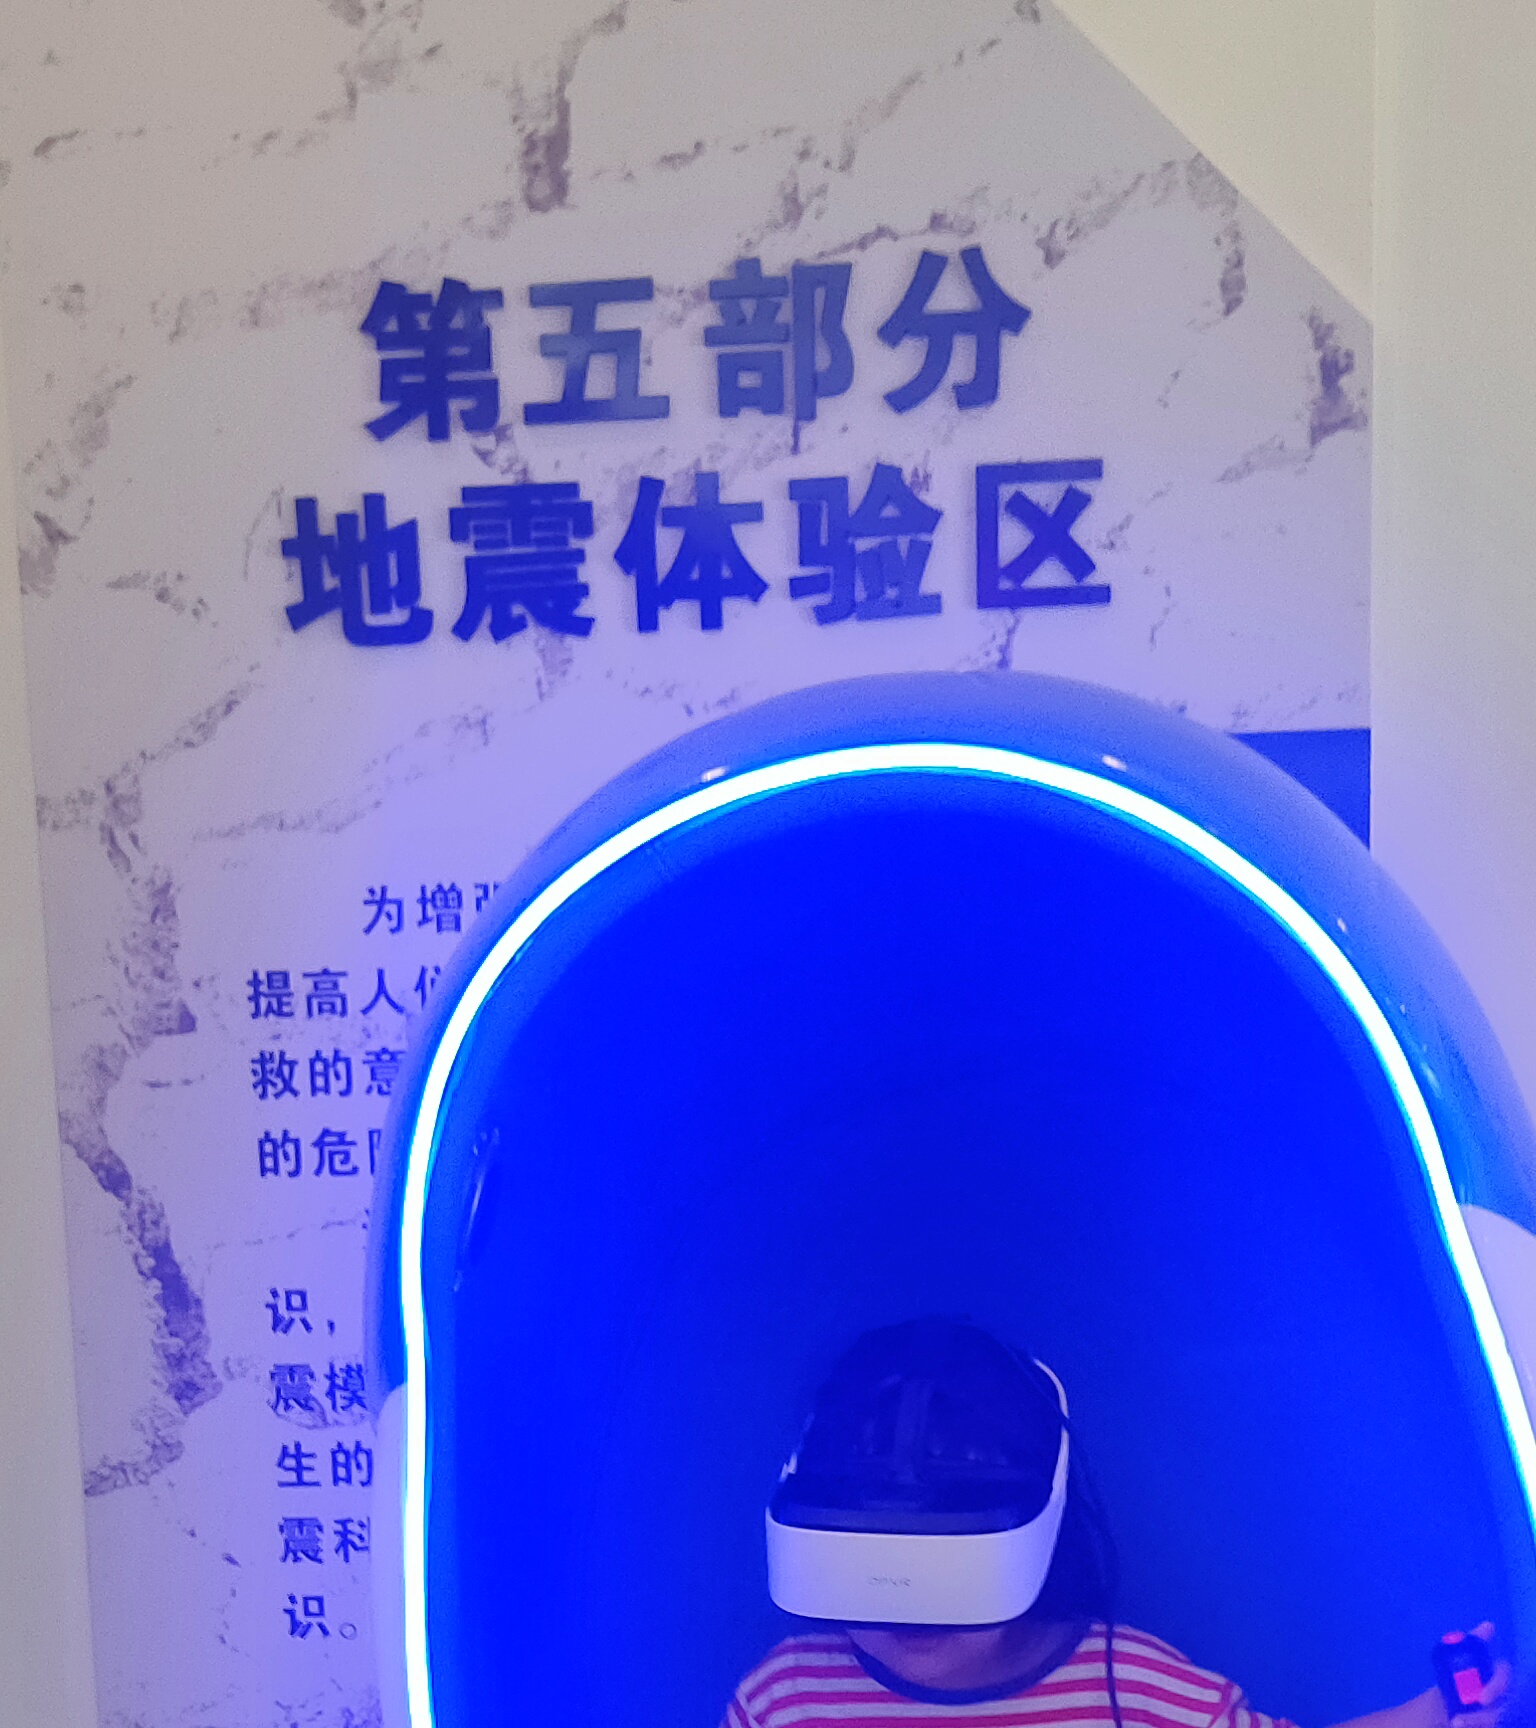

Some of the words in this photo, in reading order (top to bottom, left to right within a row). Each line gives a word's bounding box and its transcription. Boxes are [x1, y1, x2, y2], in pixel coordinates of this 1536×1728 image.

[359, 244, 1033, 443] 第五部分
[281, 457, 1112, 647] 地震体验区
[269, 1360, 368, 1414] 震模
[276, 1439, 374, 1489] 生的
[278, 1515, 371, 1565] 震科
[284, 1592, 358, 1640] 识。
